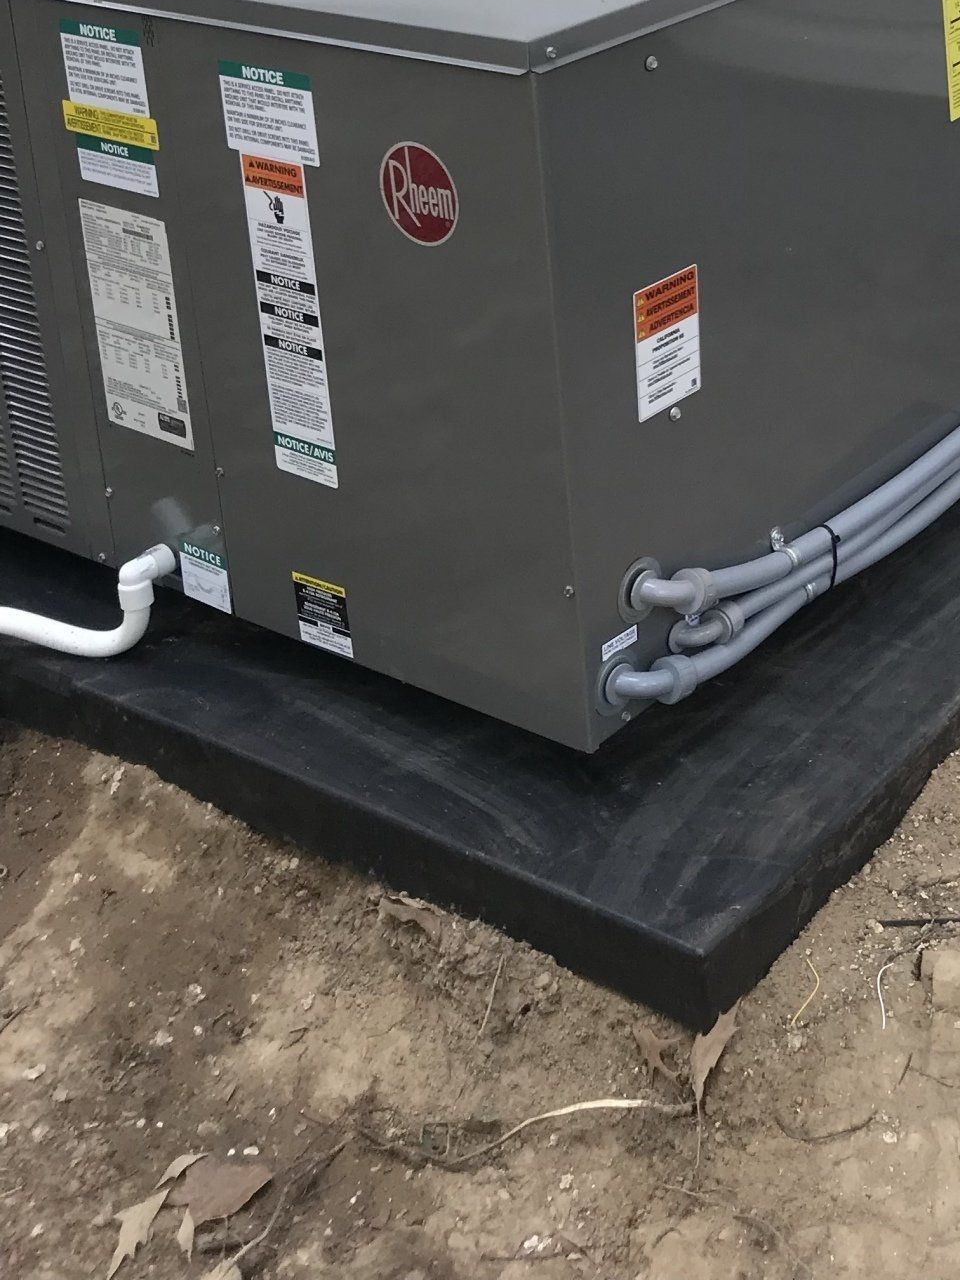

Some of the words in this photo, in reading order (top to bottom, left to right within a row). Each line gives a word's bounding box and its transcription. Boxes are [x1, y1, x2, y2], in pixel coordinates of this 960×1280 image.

[79, 23, 116, 41] NOTICE
[241, 65, 285, 85] NOTICE
[100, 141, 129, 157] NOTICE
[256, 160, 297, 178] WARNING
[251, 175, 303, 194] AVERTISSEMENT
[388, 146, 455, 228] Rheem
[270, 275, 300, 290] NOTICE
[645, 271, 694, 300] WARNING
[646, 286, 695, 316] AVERTISSEMENT
[274, 306, 304, 322] NOTICE
[650, 303, 694, 331] ADVERTENCIA
[278, 339, 308, 356] NOTICE
[277, 434, 334, 462] NOTICE/AVIS
[184, 542, 221, 566] NOTICE
